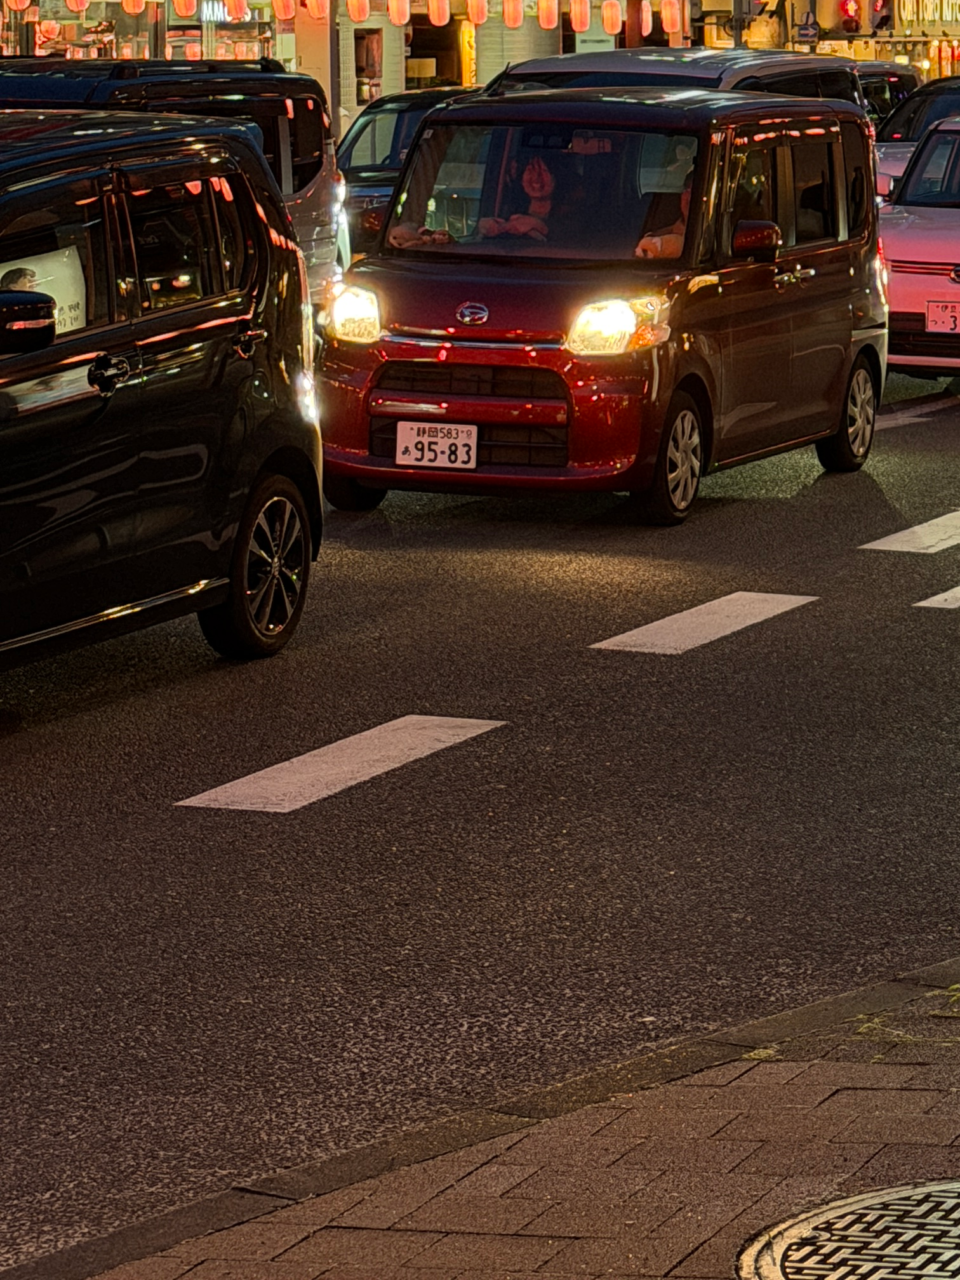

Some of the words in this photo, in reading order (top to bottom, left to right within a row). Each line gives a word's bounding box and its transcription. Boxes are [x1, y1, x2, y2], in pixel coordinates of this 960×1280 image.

[416, 426, 438, 438] 静岡
[439, 427, 459, 440] 583
[414, 440, 472, 465] 95-83
